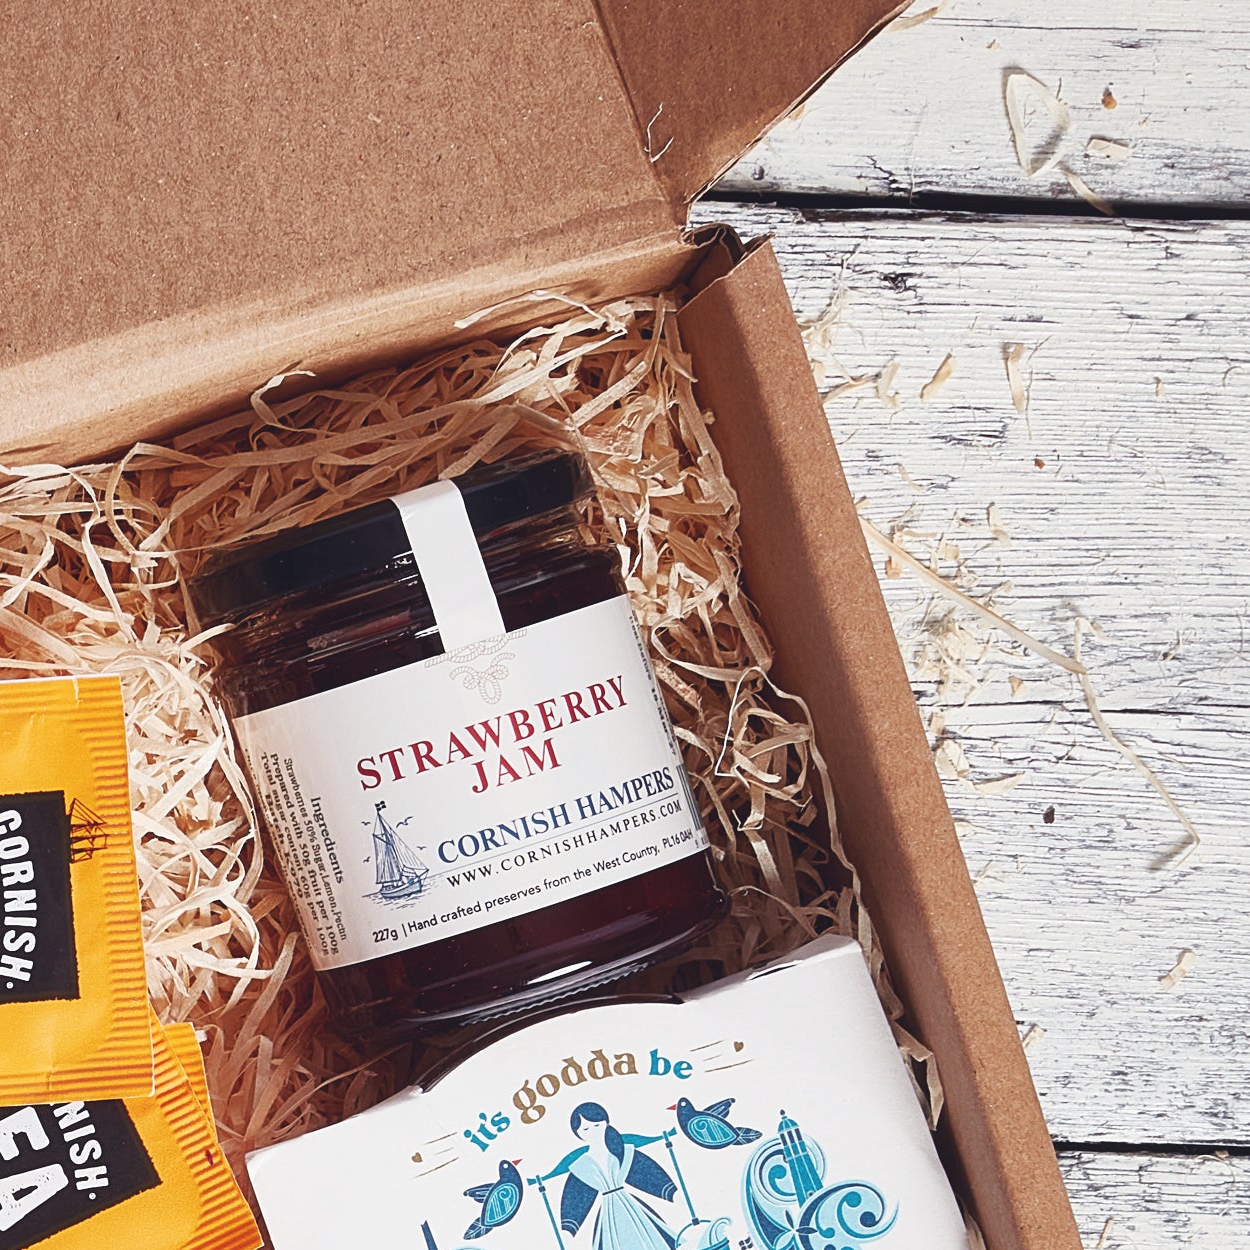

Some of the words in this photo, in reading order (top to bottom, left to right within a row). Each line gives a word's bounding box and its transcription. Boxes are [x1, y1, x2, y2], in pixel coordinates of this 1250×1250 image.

[356, 675, 628, 791] STRAWBERRY
[472, 738, 562, 794] JAM
[261, 751, 274, 786] Total
[272, 789, 286, 822] sugar
[284, 825, 302, 871] content
[299, 875, 311, 899] 60g
[307, 901, 319, 922] per
[270, 753, 295, 809] Prepared
[290, 811, 303, 839] with
[299, 843, 311, 866] 50g
[307, 868, 322, 897] fruit
[316, 901, 329, 921] per
[325, 924, 339, 955] 100g
[303, 819, 316, 843] 50%
[310, 796, 344, 885] Ingredients
[438, 803, 572, 864] CORNISH
[575, 767, 674, 820] HAMPERS
[446, 799, 683, 888] WWW.CORNISHHAMPERS.COM
[372, 927, 399, 943] 227g
[407, 915, 438, 934] Hand
[440, 901, 482, 923] crafted
[484, 884, 542, 912] preserves
[543, 874, 571, 890] from
[573, 865, 592, 879] the
[593, 856, 621, 873] West
[622, 843, 660, 864] Country,
[49, 1101, 109, 1190] NISH
[463, 1111, 511, 1152] it's
[512, 1049, 639, 1124] godda
[649, 1048, 693, 1080] be
